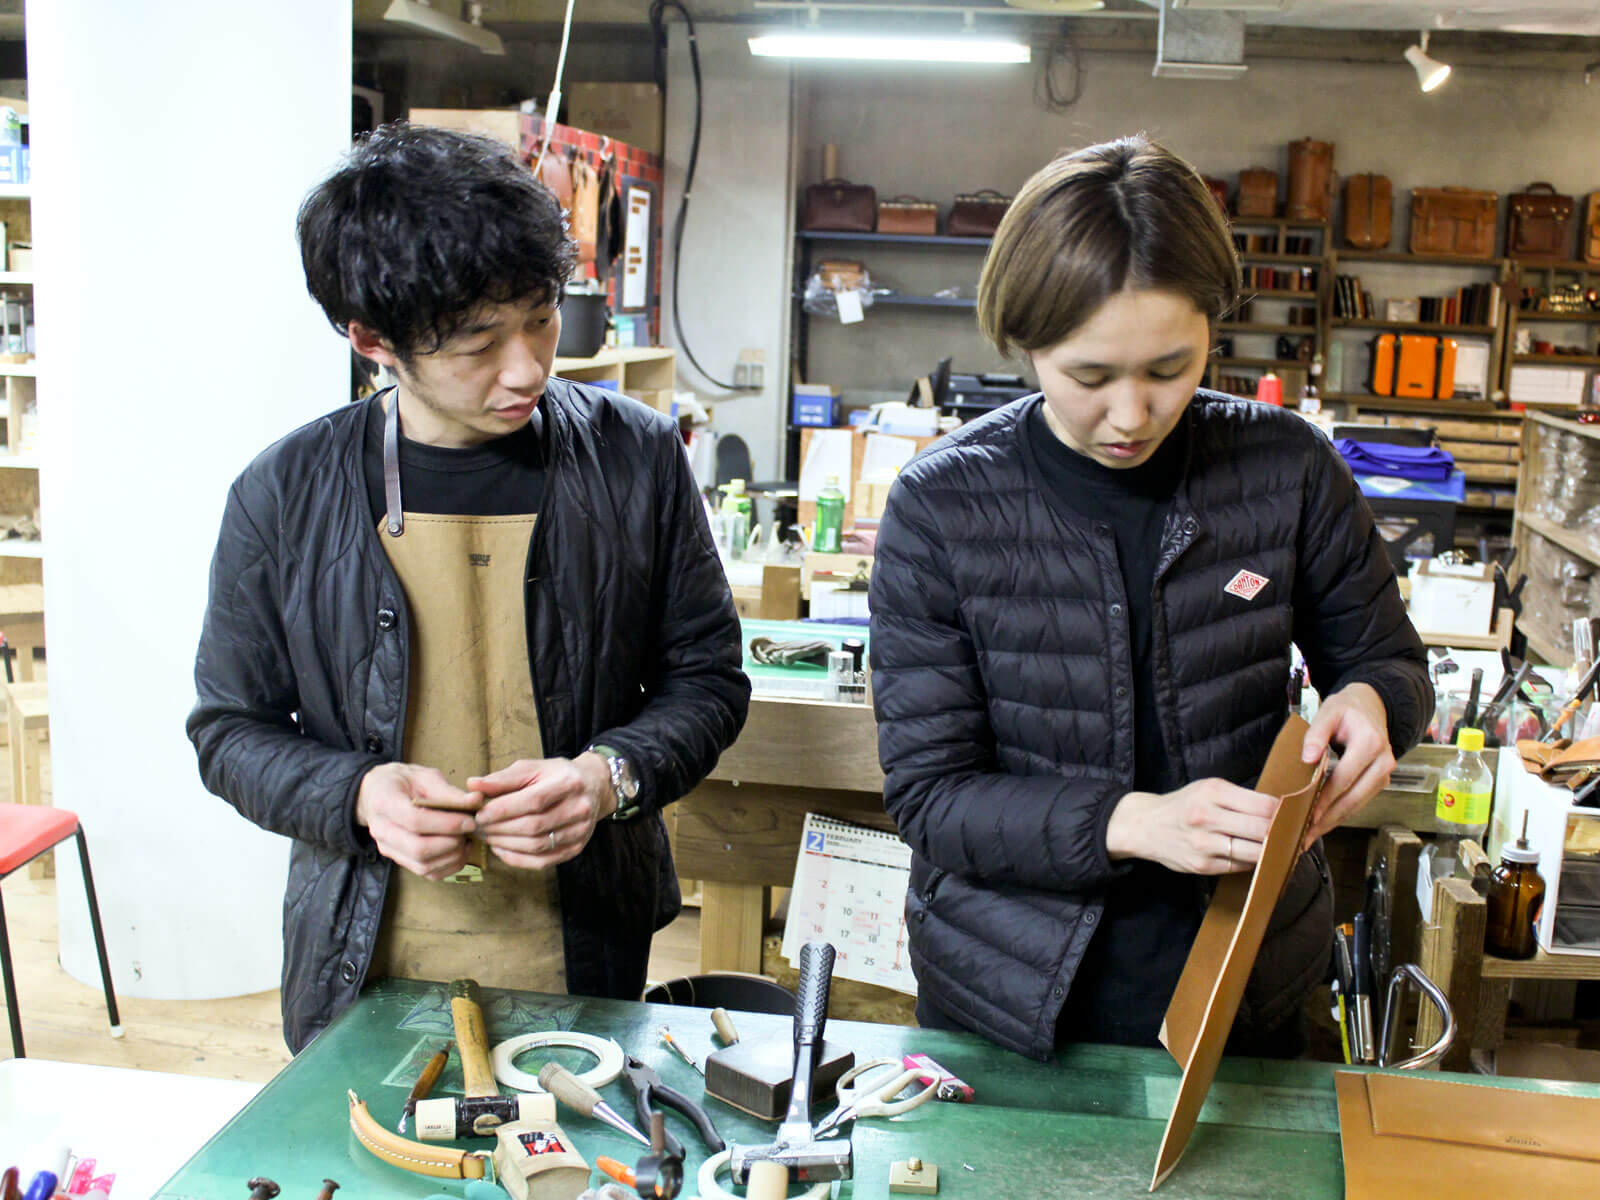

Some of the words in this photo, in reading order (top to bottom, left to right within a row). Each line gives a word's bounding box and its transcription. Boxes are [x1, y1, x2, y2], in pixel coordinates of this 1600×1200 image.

[809, 832, 823, 849] 2
[826, 833, 862, 844] FEBRUARY
[821, 880, 828, 889] 2
[843, 907, 853, 916] 10
[870, 912, 879, 920] 11
[813, 924, 823, 933] 16
[841, 929, 850, 938] 17
[868, 935, 877, 944] 18
[864, 956, 874, 966] 25
